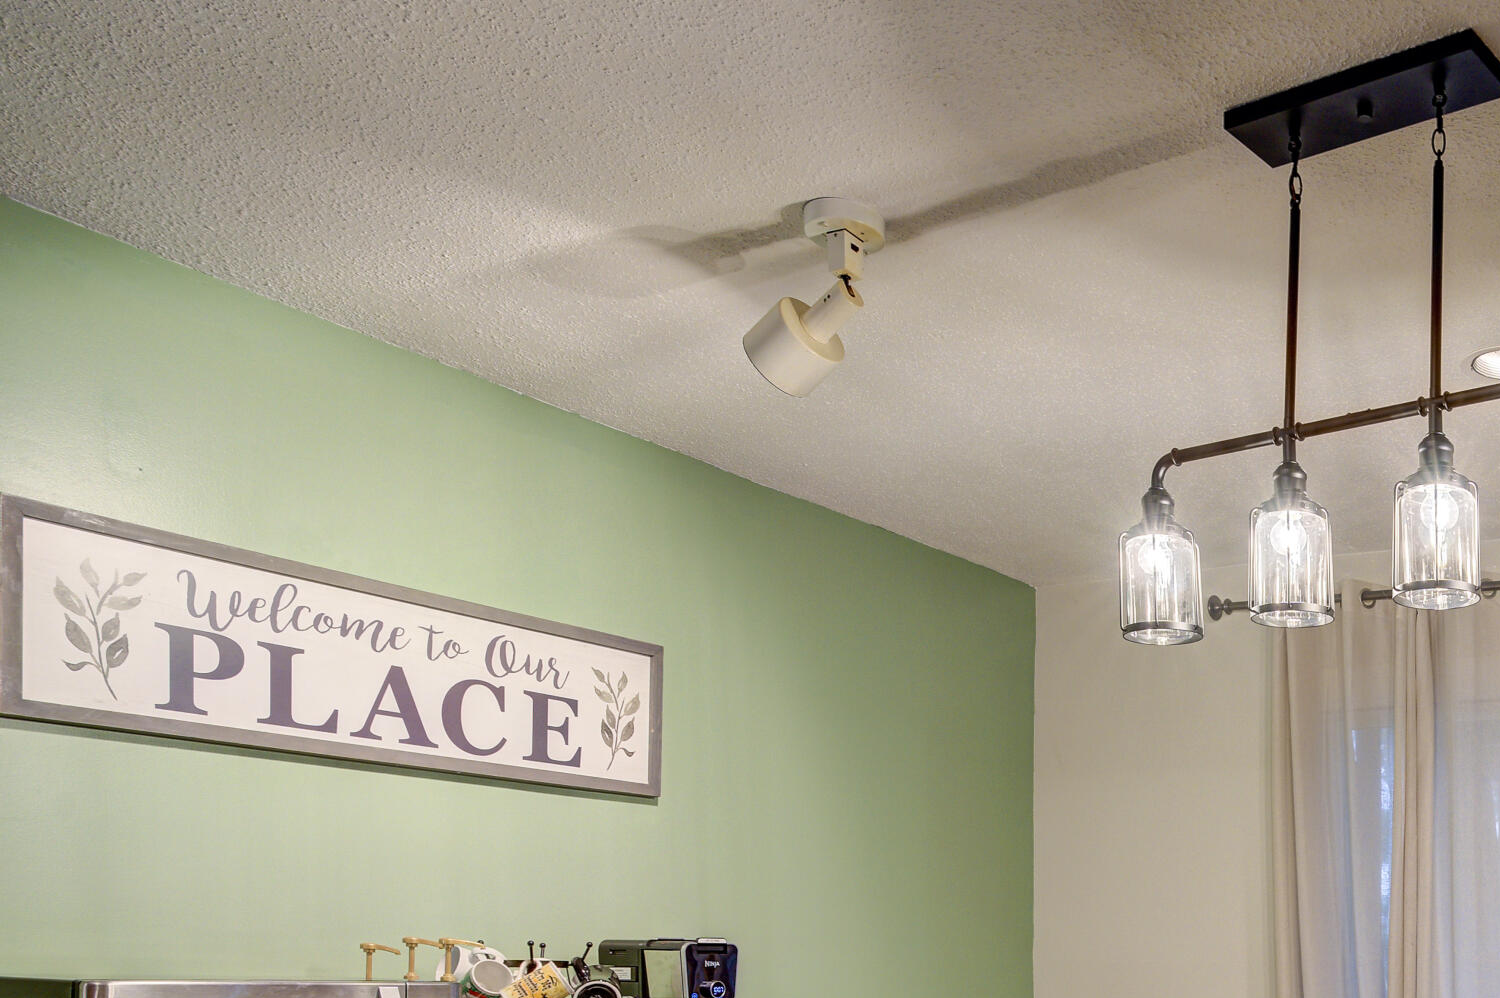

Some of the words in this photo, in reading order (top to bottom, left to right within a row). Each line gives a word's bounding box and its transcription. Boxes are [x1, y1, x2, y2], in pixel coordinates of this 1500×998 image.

[153, 621, 582, 768] PLACE
[176, 569, 411, 653] Welcome
[419, 625, 470, 661] to
[484, 634, 570, 690] Our
